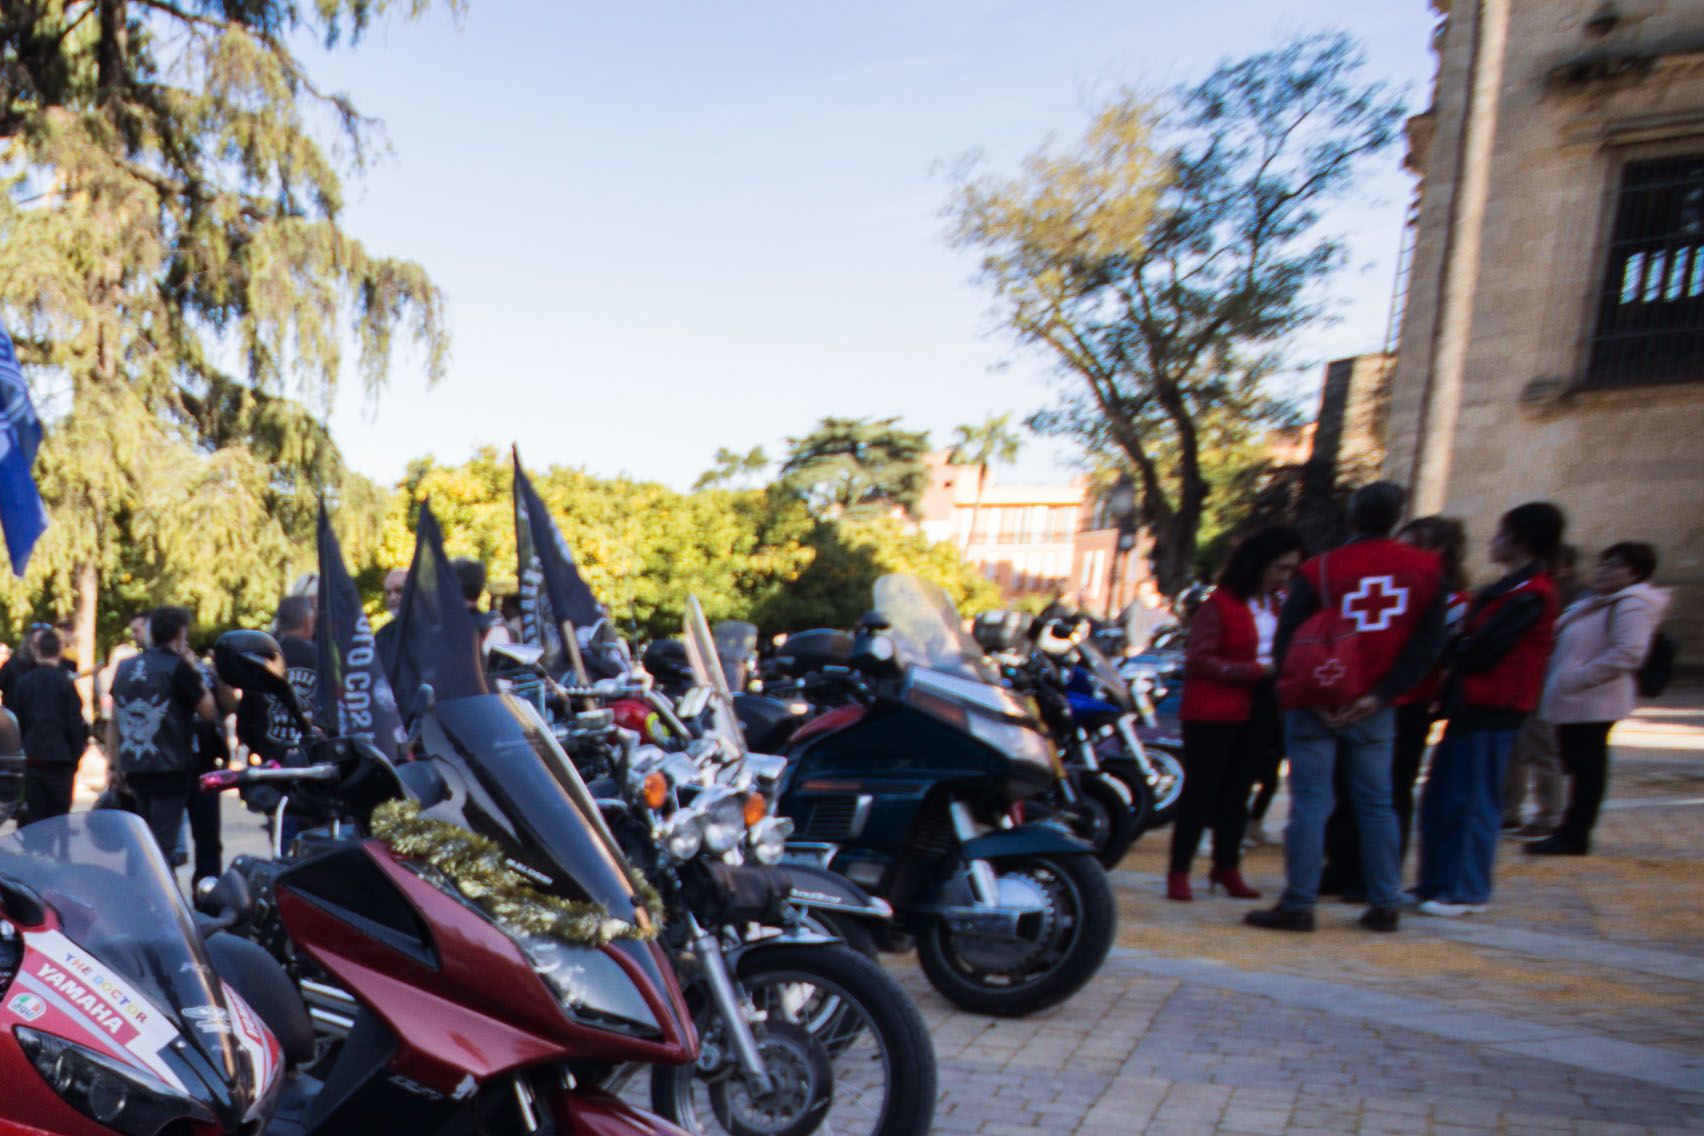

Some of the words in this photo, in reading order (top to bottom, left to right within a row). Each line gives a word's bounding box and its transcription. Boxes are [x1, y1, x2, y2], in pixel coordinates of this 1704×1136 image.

[36, 963, 125, 1035] YAMAHA
[64, 953, 94, 976] THE
[93, 974, 148, 1024] DOCTOR
